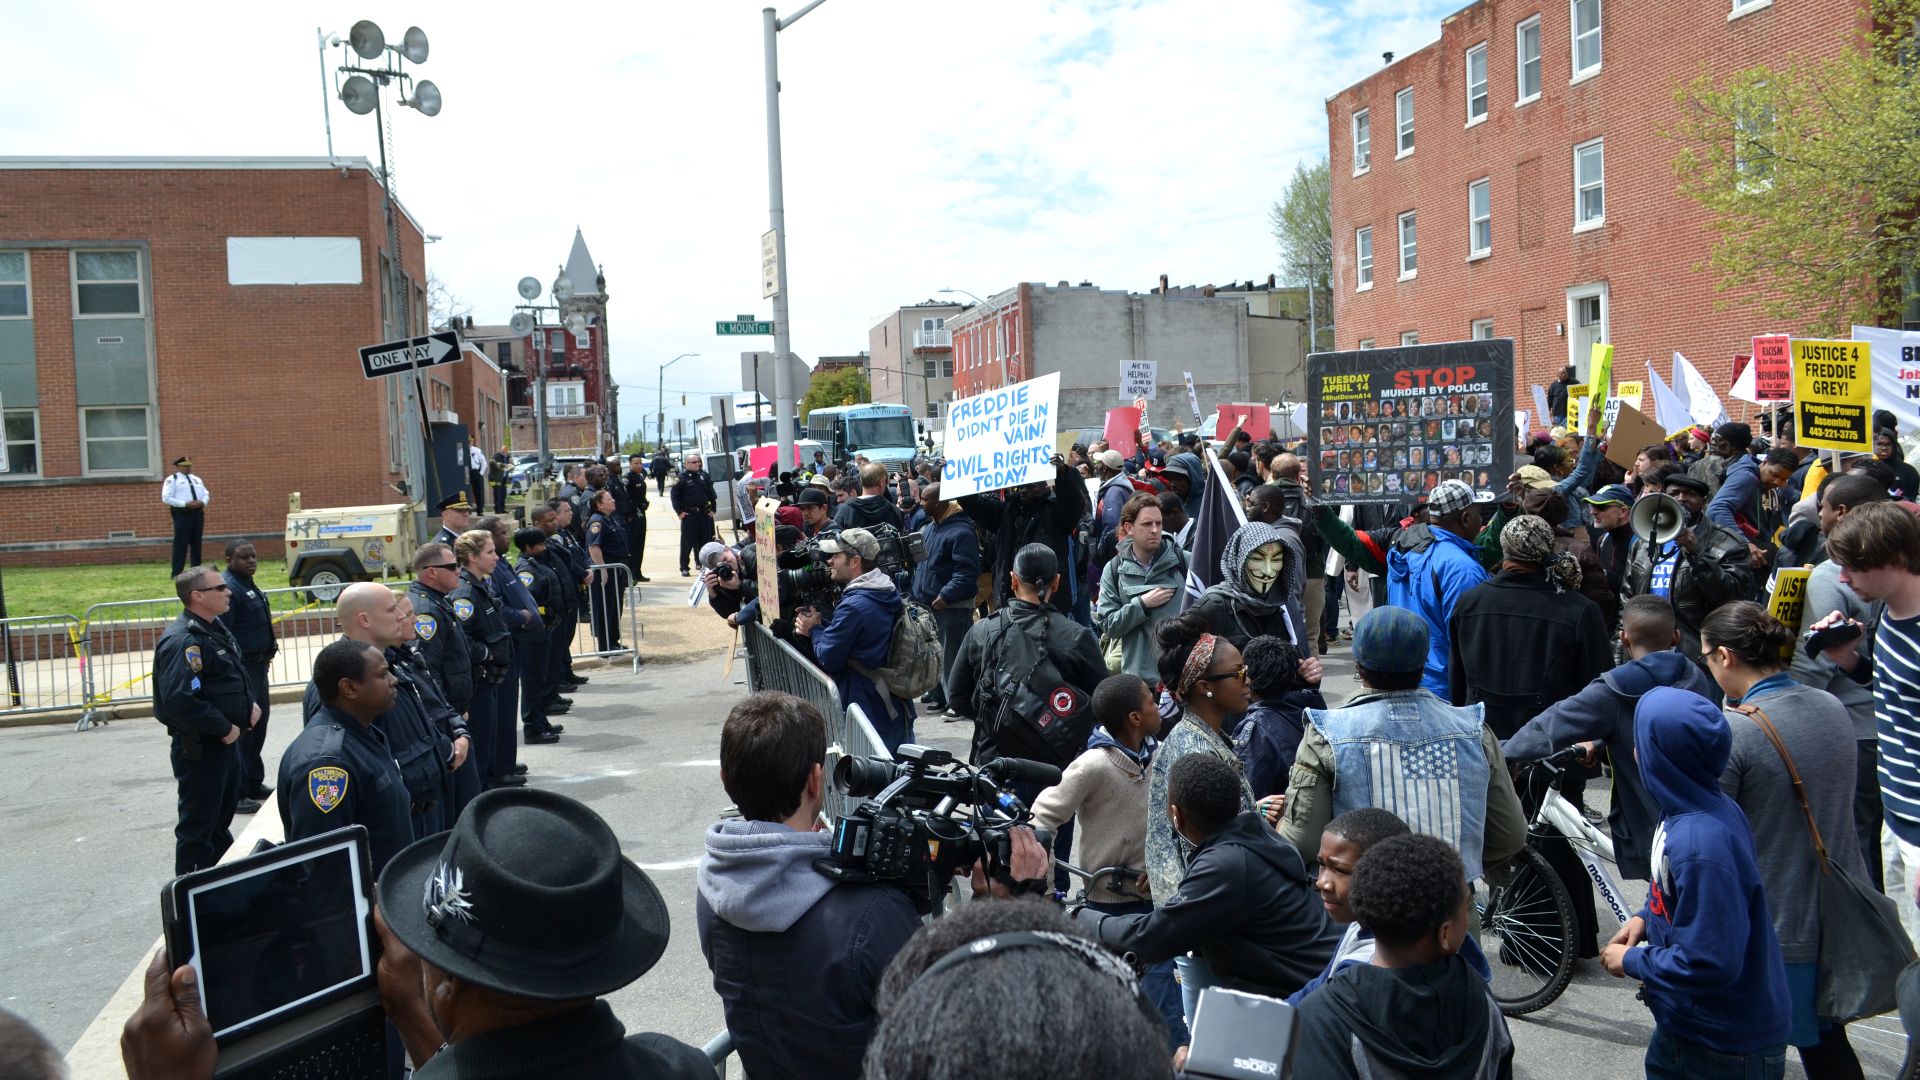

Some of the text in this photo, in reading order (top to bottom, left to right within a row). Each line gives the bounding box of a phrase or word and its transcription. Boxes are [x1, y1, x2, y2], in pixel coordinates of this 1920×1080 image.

[719, 323, 727, 333] N.
[730, 323, 760, 333] MOUNT
[1762, 346, 1783, 356] RACISM
[1802, 346, 1859, 361] JUSTICE 4
[373, 352, 400, 367] ONE
[1128, 370, 1153, 379] HELPING?
[1394, 366, 1476, 389] STOP
[1757, 371, 1789, 380] REVOLUTION
[1805, 363, 1856, 379] FREDDIE
[1322, 374, 1370, 385] TUESDAY
[1128, 386, 1152, 395] HURTING?
[1322, 382, 1369, 393] APRIL 14
[1381, 382, 1488, 398] MURDER BY POLICE
[1813, 381, 1849, 396] GREY!
[1322, 393, 1371, 401] #ShutDownA14
[951, 384, 1029, 428] FREDDIE
[1805, 403, 1860, 416] Peoples Power
[958, 402, 1048, 441] DIDN'T DIE IN
[1814, 416, 1851, 428] Assembly
[1004, 419, 1046, 445] VAIN!
[1809, 427, 1859, 440] 443-221-3775
[944, 444, 1051, 480] CIVIL RIGHTS
[973, 465, 1028, 491] TODAY!
[1587, 863, 1627, 923] mongoose
